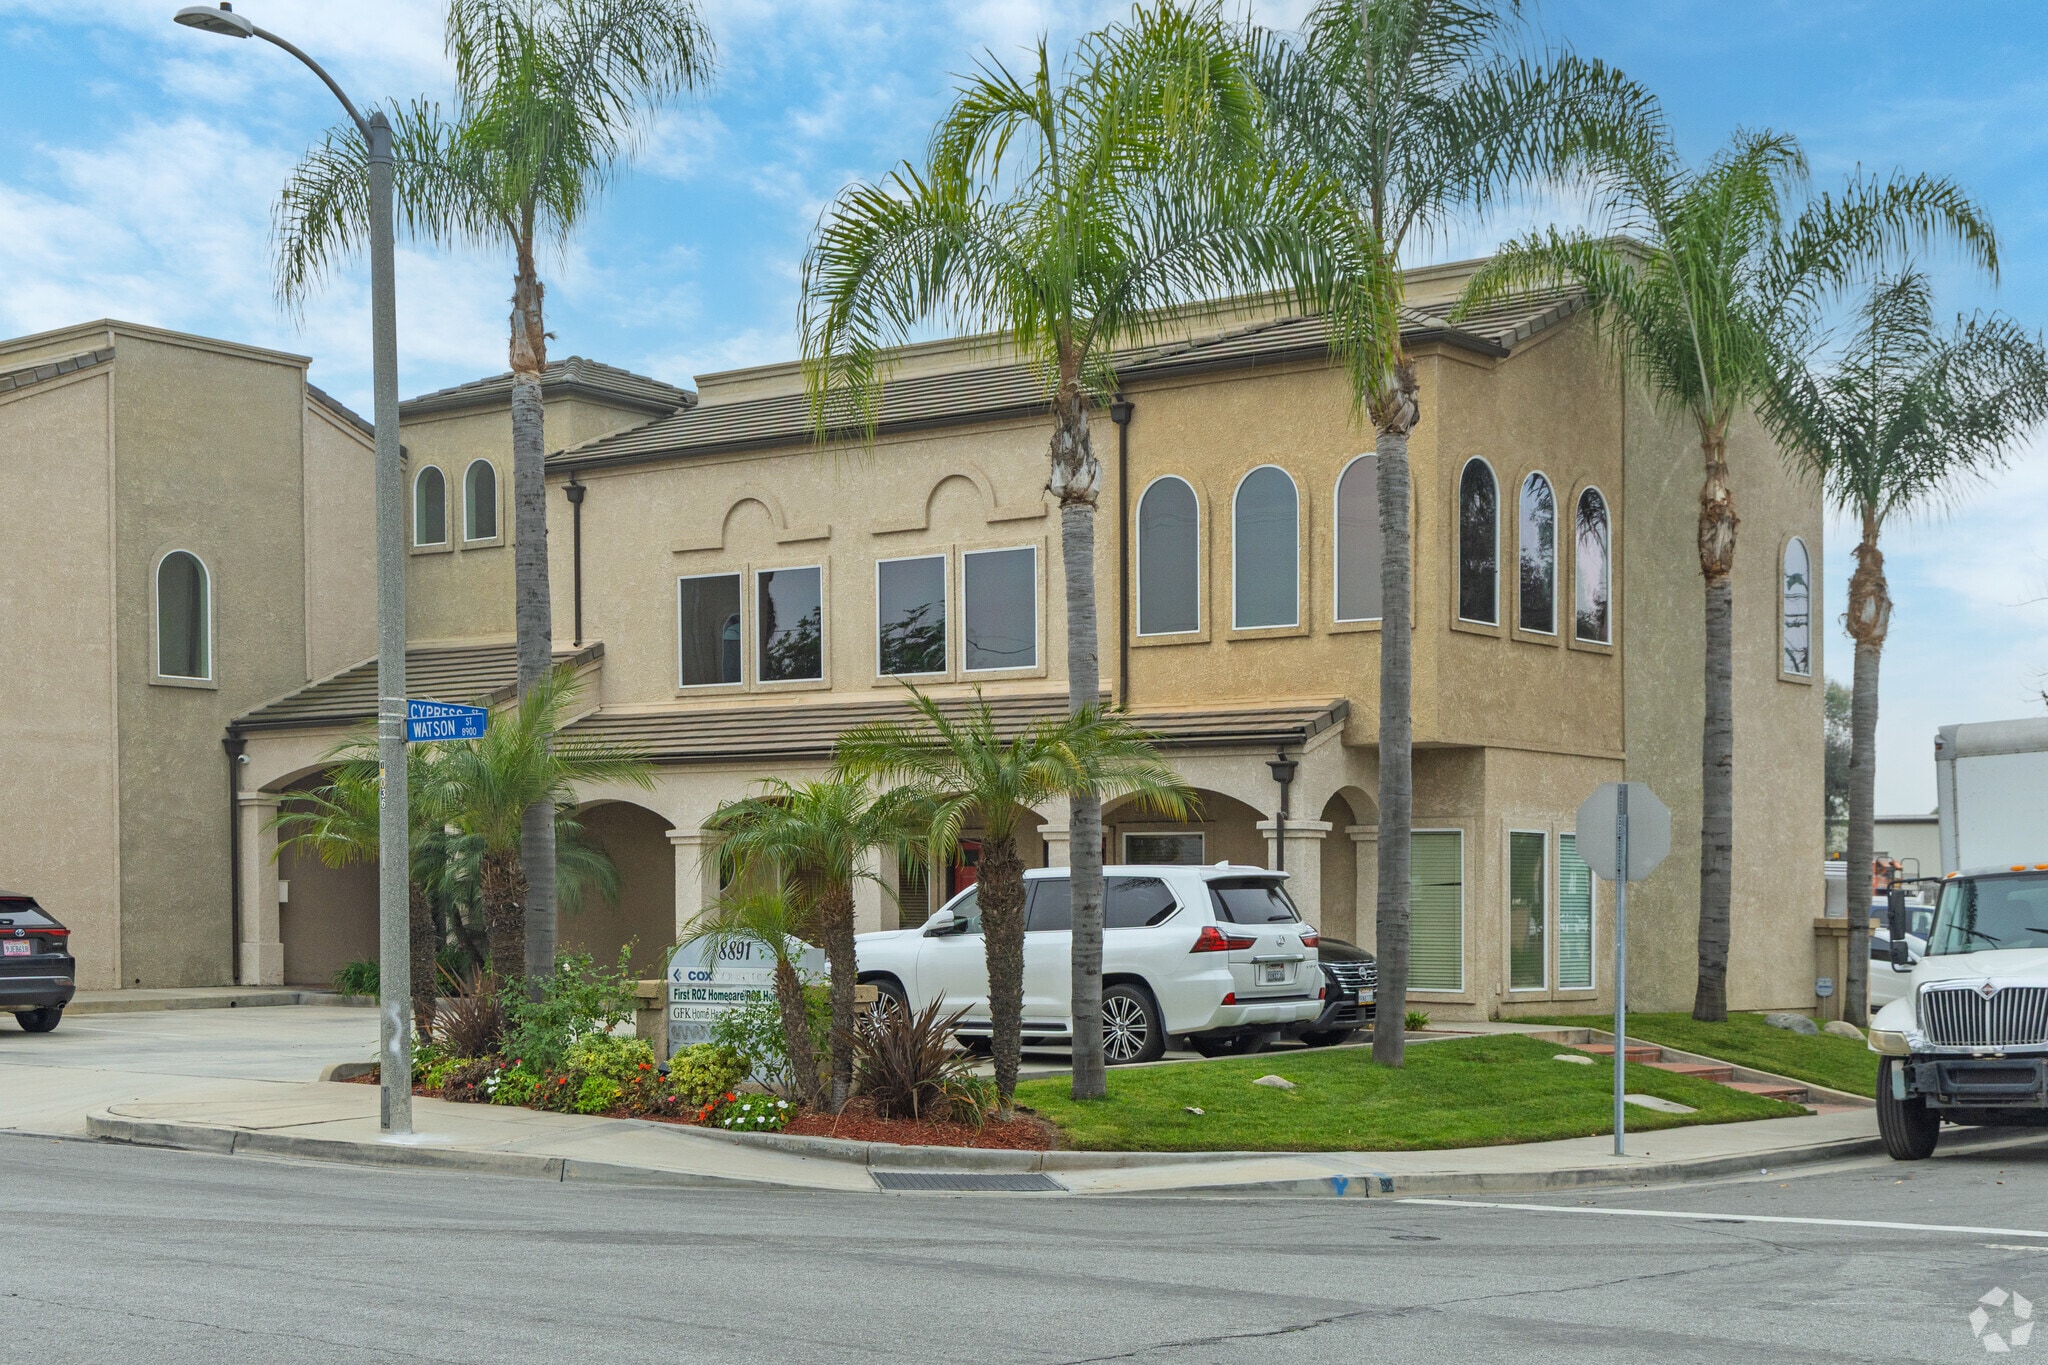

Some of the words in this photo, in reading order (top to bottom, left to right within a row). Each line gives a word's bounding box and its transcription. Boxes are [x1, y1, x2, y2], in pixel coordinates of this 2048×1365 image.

[465, 717, 472, 726] ST
[413, 720, 456, 738] WATSON
[461, 727, 477, 736] 8900
[719, 940, 751, 960] 8891
[674, 988, 690, 1000] First
[691, 989, 707, 1000] ROZ
[708, 989, 745, 1001] Homecare
[673, 1008, 691, 1019] GFK
[692, 1008, 710, 1019] Home
